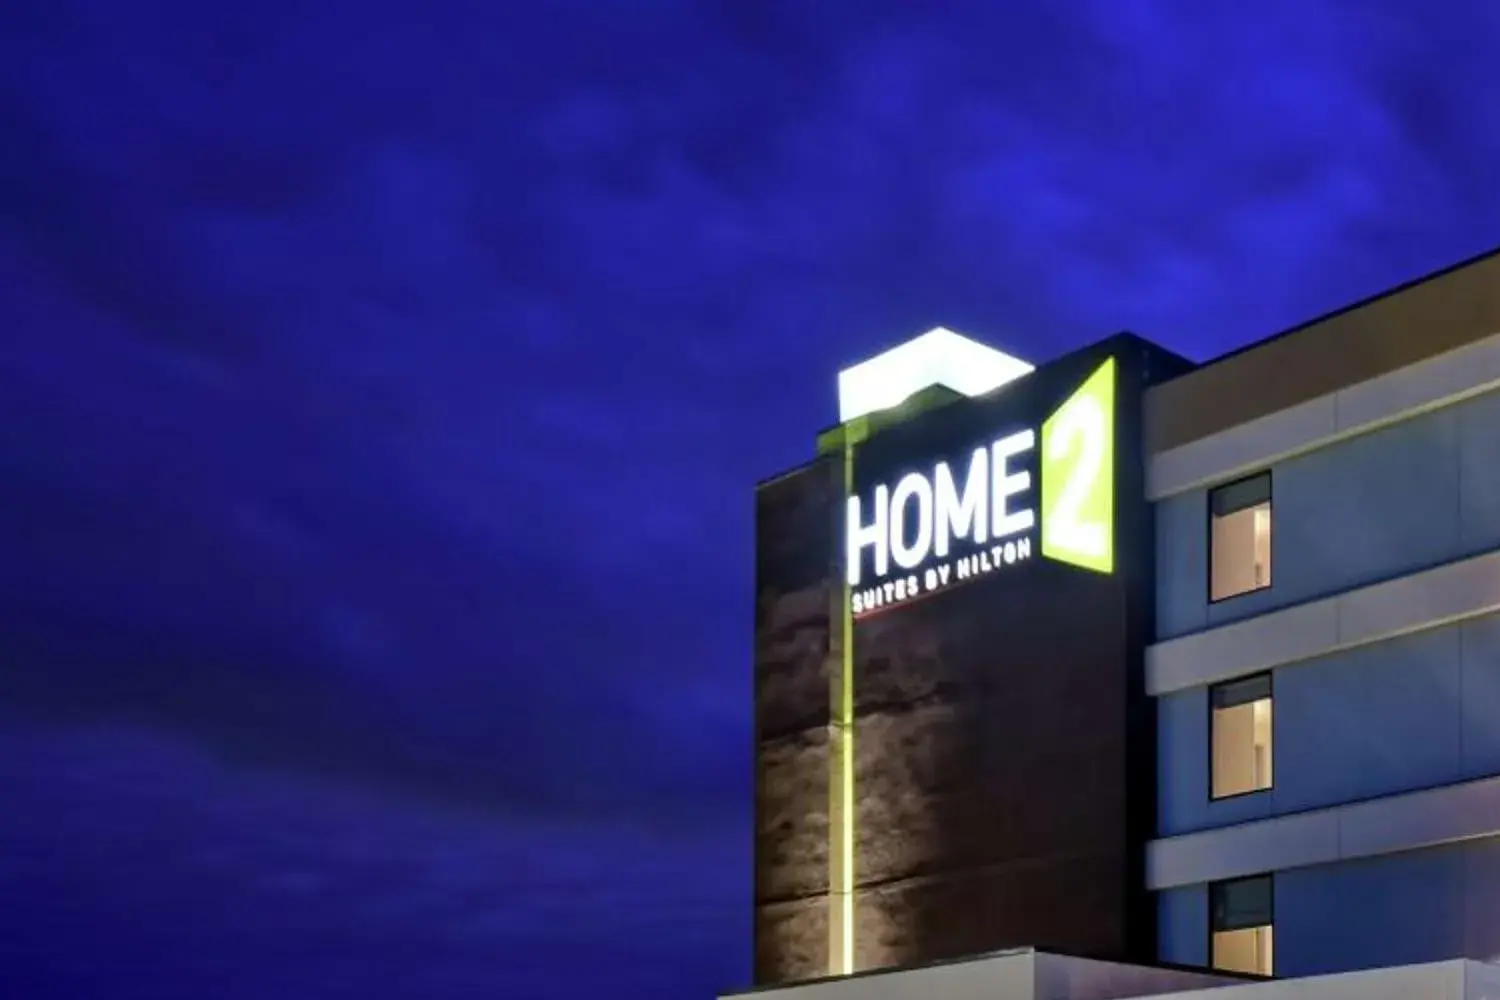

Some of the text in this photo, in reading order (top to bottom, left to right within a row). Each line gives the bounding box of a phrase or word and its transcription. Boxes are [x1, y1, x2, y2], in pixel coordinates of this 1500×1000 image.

[847, 393, 1110, 586] HOME 2
[852, 537, 1031, 613] SUITES BY HILTON
